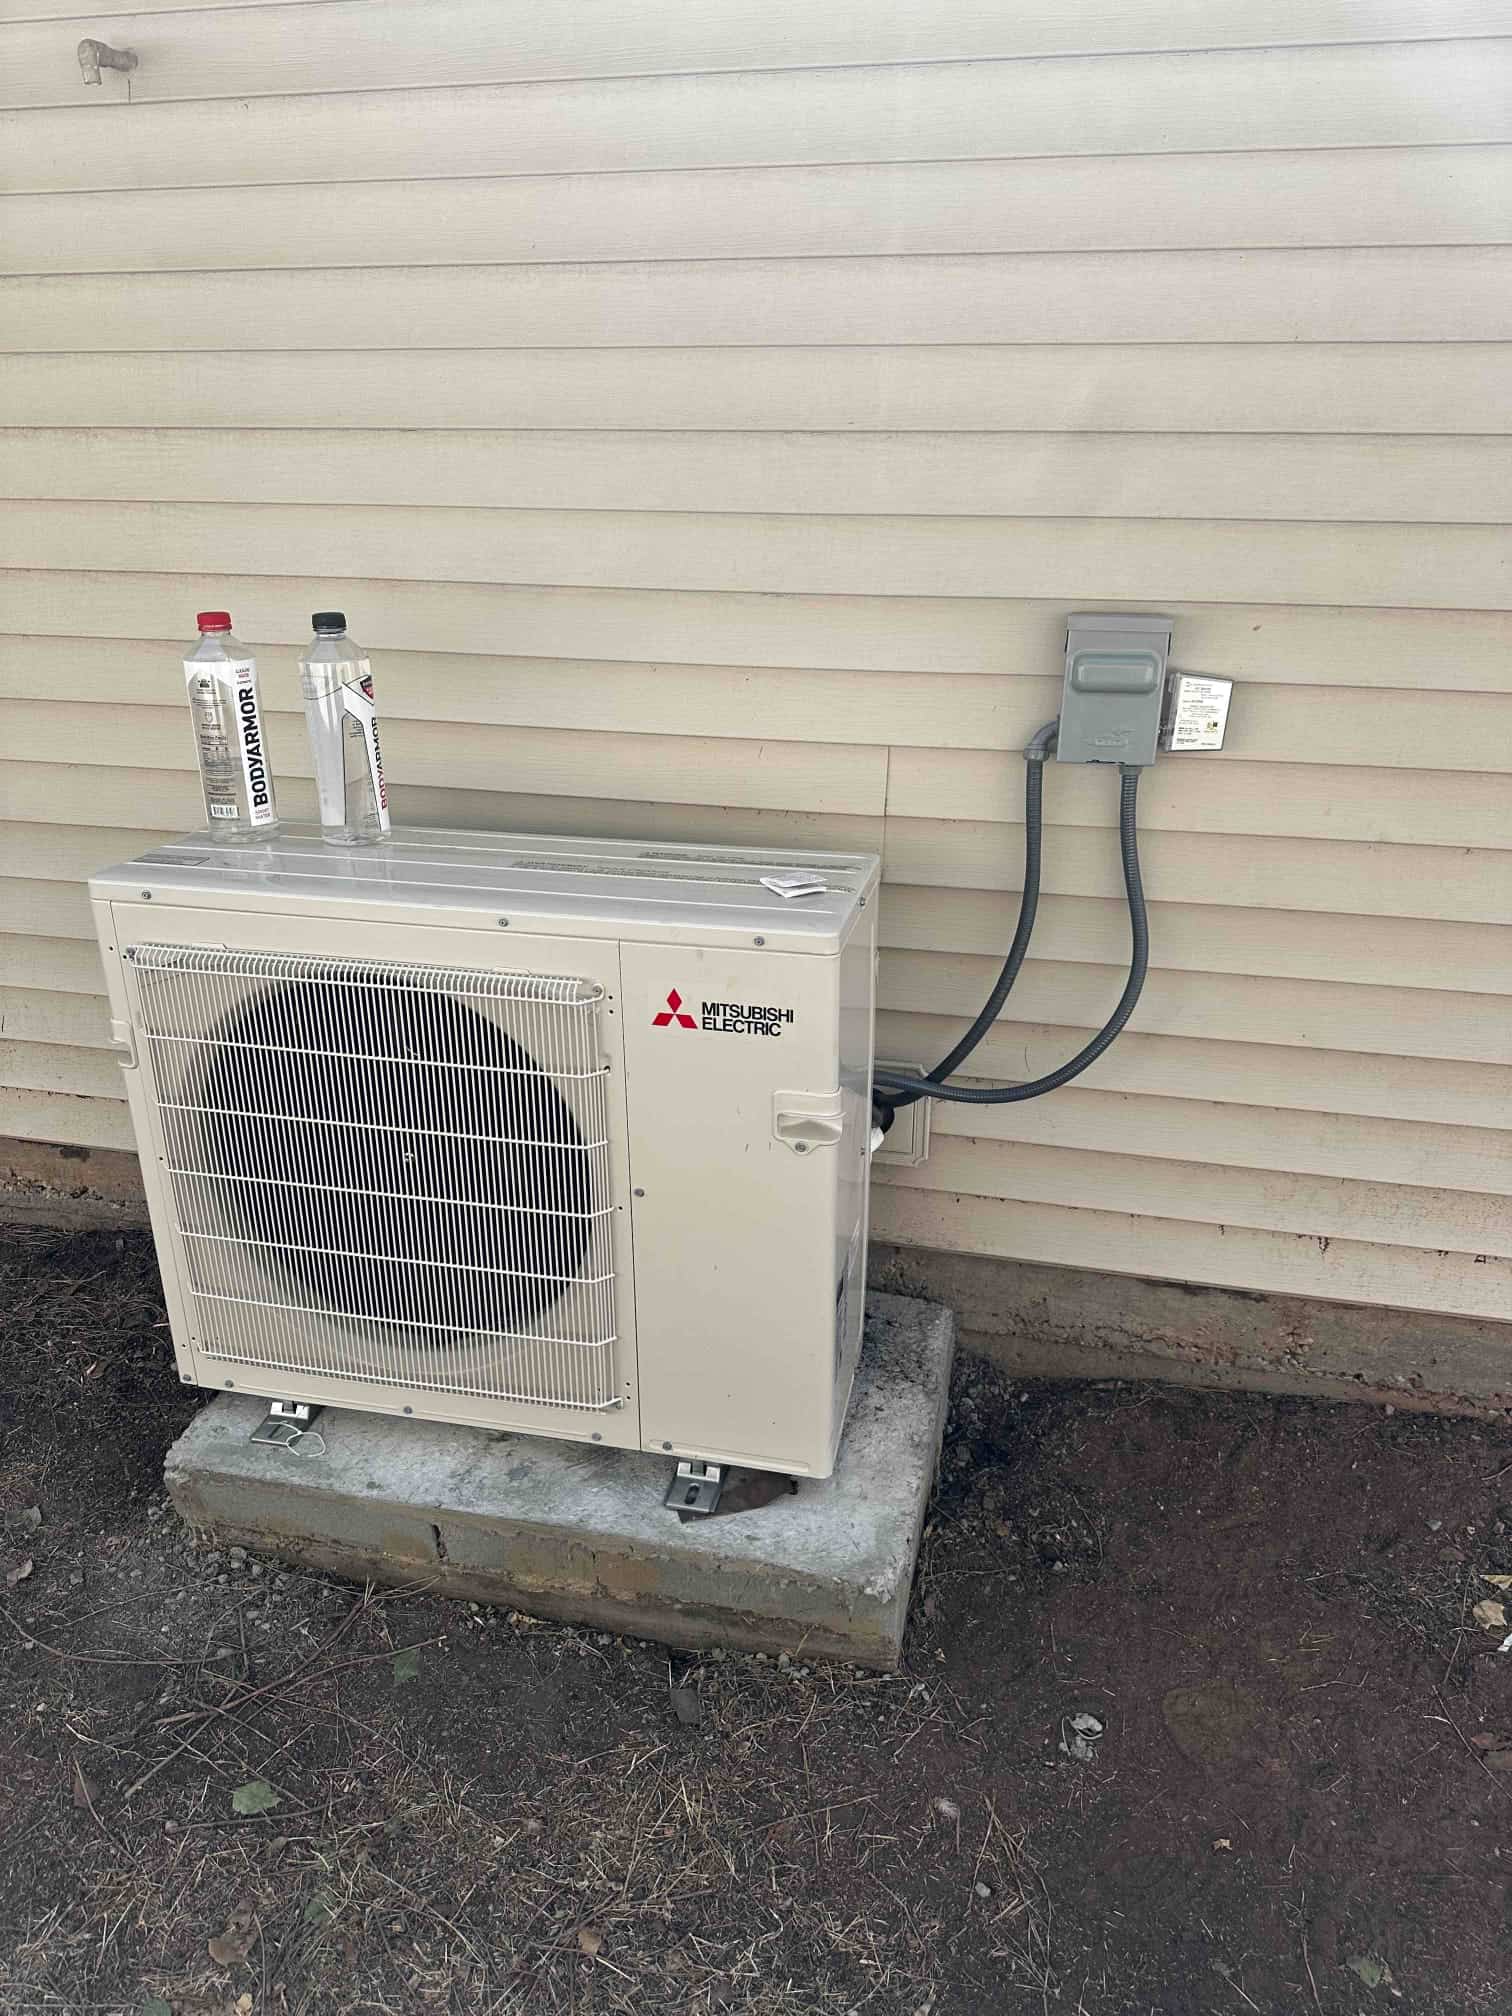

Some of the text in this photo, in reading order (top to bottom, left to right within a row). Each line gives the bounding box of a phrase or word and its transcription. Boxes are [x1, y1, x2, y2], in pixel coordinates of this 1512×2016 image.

[238, 687, 269, 808] BODYARMOR
[702, 1001, 794, 1023] MITSUBISHI
[702, 1017, 781, 1036] ELECTRIC
